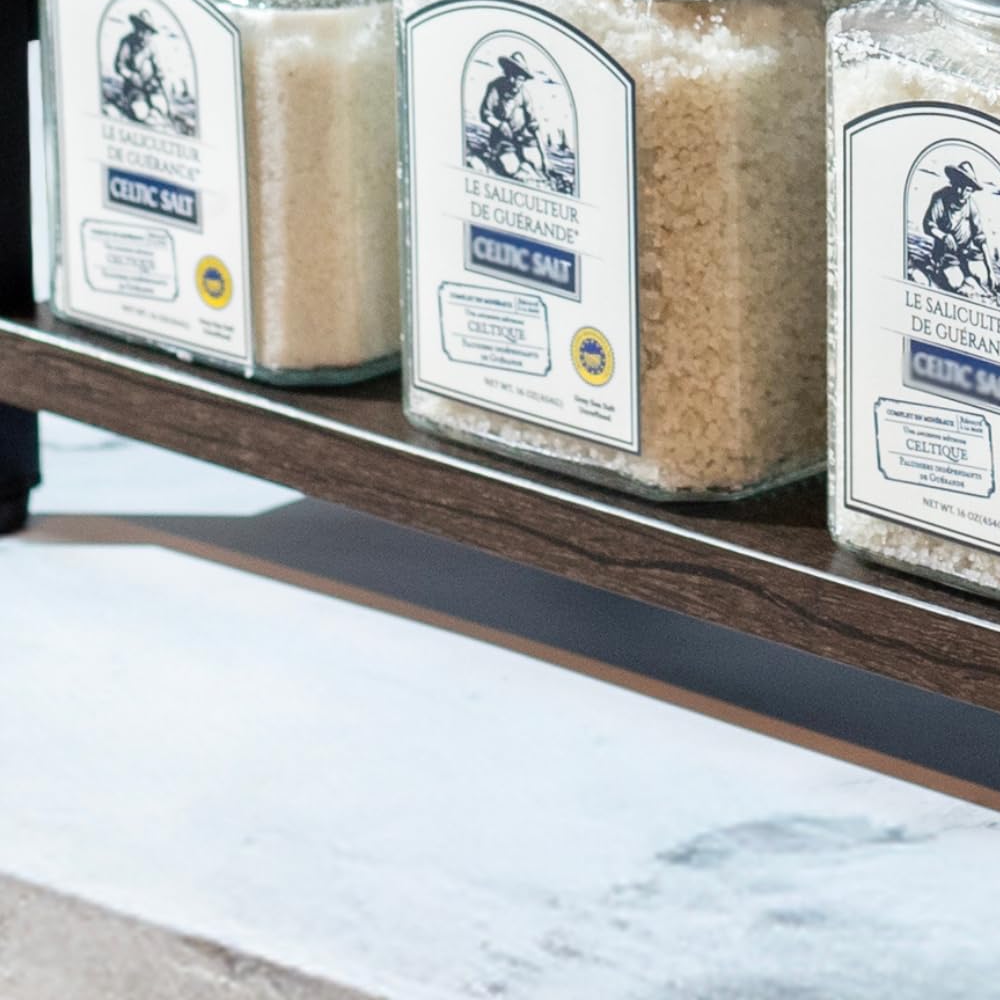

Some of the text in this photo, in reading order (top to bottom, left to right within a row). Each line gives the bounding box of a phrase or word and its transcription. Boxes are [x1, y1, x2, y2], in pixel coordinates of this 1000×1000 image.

[110, 177, 194, 218] CELTIC SALT
[465, 177, 580, 224] LE SALICULTEUR
[471, 201, 490, 220] DE
[474, 236, 572, 284] CELTIC SALT
[905, 290, 922, 311] LE
[467, 321, 526, 344] CELTIQUE
[911, 315, 932, 336] DE
[913, 351, 973, 391] CELTIC
[905, 439, 969, 463] CELTIQUE
[923, 496, 939, 510] NET
